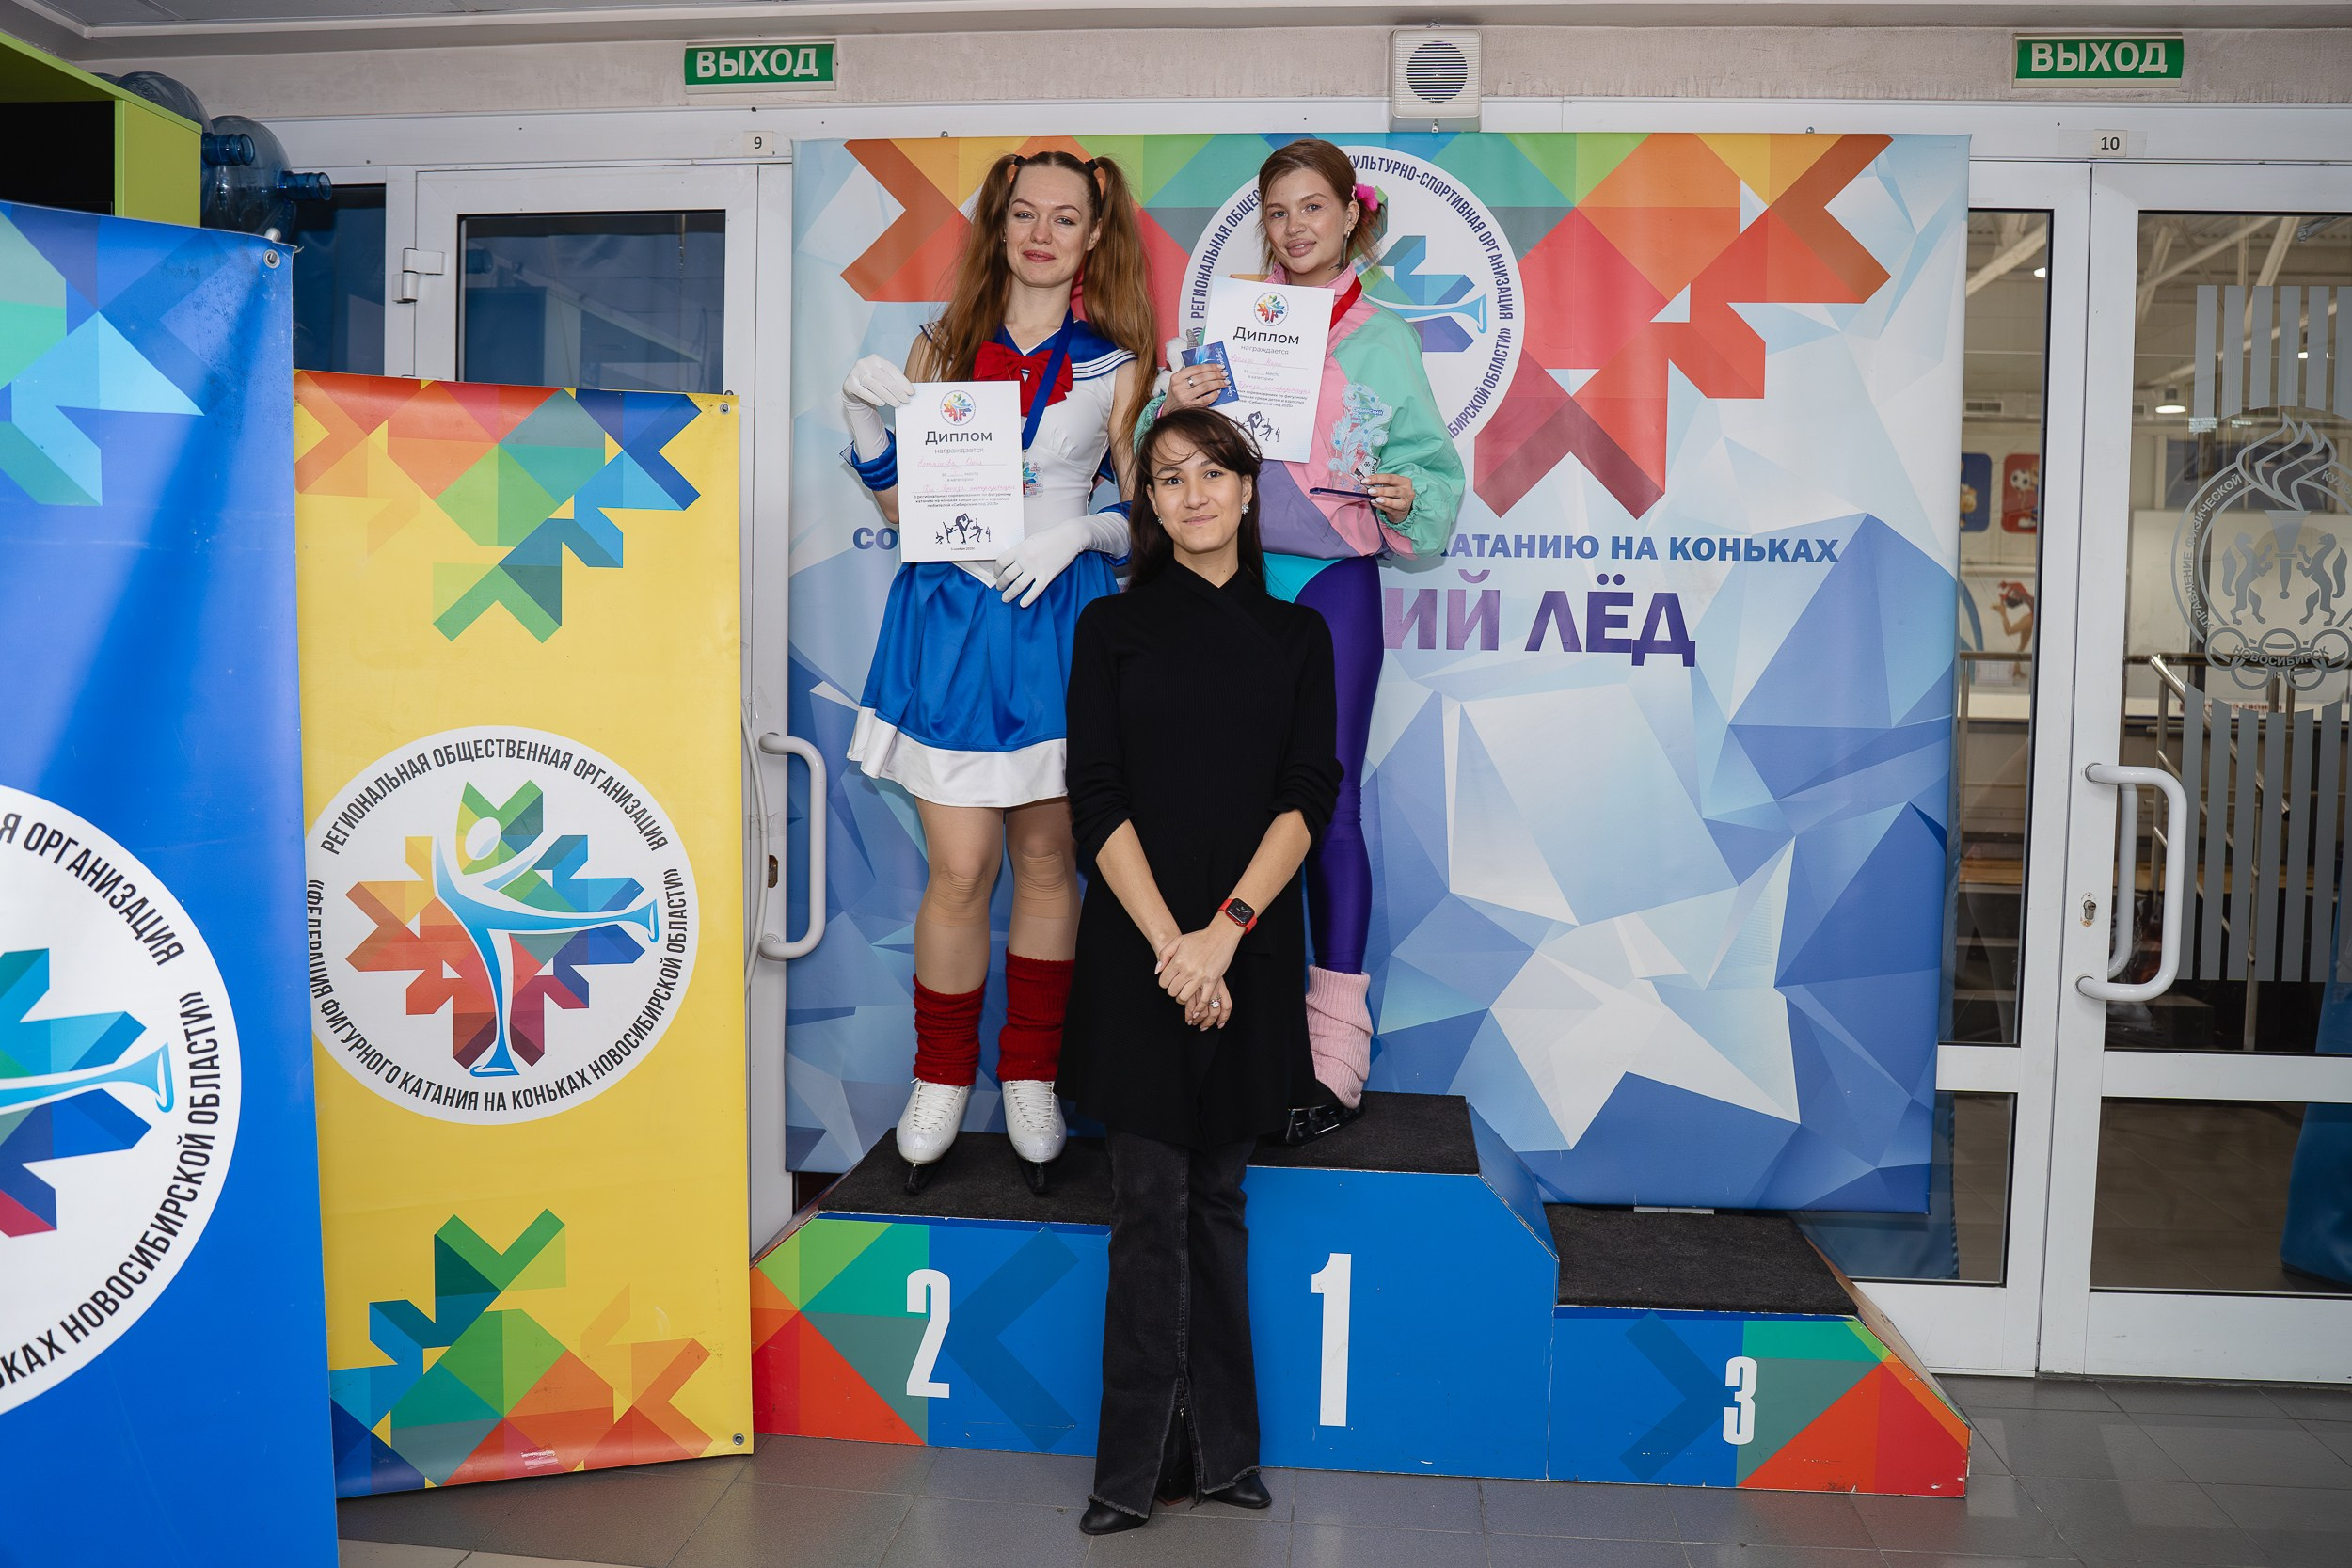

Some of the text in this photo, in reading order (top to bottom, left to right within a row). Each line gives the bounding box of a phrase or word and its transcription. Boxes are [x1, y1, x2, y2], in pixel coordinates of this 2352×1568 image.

[697, 49, 818, 78] ВЫХОД
[2031, 42, 2168, 74] ВЫХОД
[754, 136, 762, 149] 9
[2101, 136, 2120, 150] 10
[1191, 224, 1232, 319] РЕГИОНАЛЬНАЯ
[1478, 230, 1514, 320] ОРГАНИЗАЦИЯ
[1232, 326, 1300, 345] Диплом
[1240, 344, 1289, 356] награждается
[1447, 327, 1512, 439] БИРСКОЙ ОБЛАСТИ»
[925, 431, 993, 445] Диплом
[934, 447, 984, 455] награждается
[1440, 533, 1600, 559] АТАНИЮ
[1611, 535, 1659, 561] НА
[1669, 536, 1839, 562] КОНЬКАХ
[2185, 473, 2243, 548] ФИЗИЧЕСКОЙ
[1524, 573, 1696, 668] ЛЁД
[2182, 551, 2215, 629] УПРАВЛЕНИЕ
[2233, 643, 2330, 667] НОВОСИБИРСК
[321, 738, 669, 855] РЕГИОНАЛЬНАЯ ОБЩЕСТВЕННАЯ ОРГАНИЗАЦИЯ
[24, 822, 185, 966] ОРГАНИЗАЦИЯ
[320, 998, 402, 1085] ФИГУРНОГО
[398, 1073, 479, 1111] КАТАНИЯ
[484, 1091, 508, 1112] НА
[511, 1070, 593, 1111] КОНЬКАХ
[587, 958, 684, 1081] НОВОСИБИРСКОЙ
[663, 867, 689, 954] ОБЛАСТИ»
[58, 1133, 215, 1344] НОВОСИБИРСКОЙ
[179, 990, 222, 1126] ОБЛАСТИ»
[906, 1269, 951, 1399] 2
[1311, 1253, 1352, 1428] 1
[1723, 1356, 1756, 1446] 3
